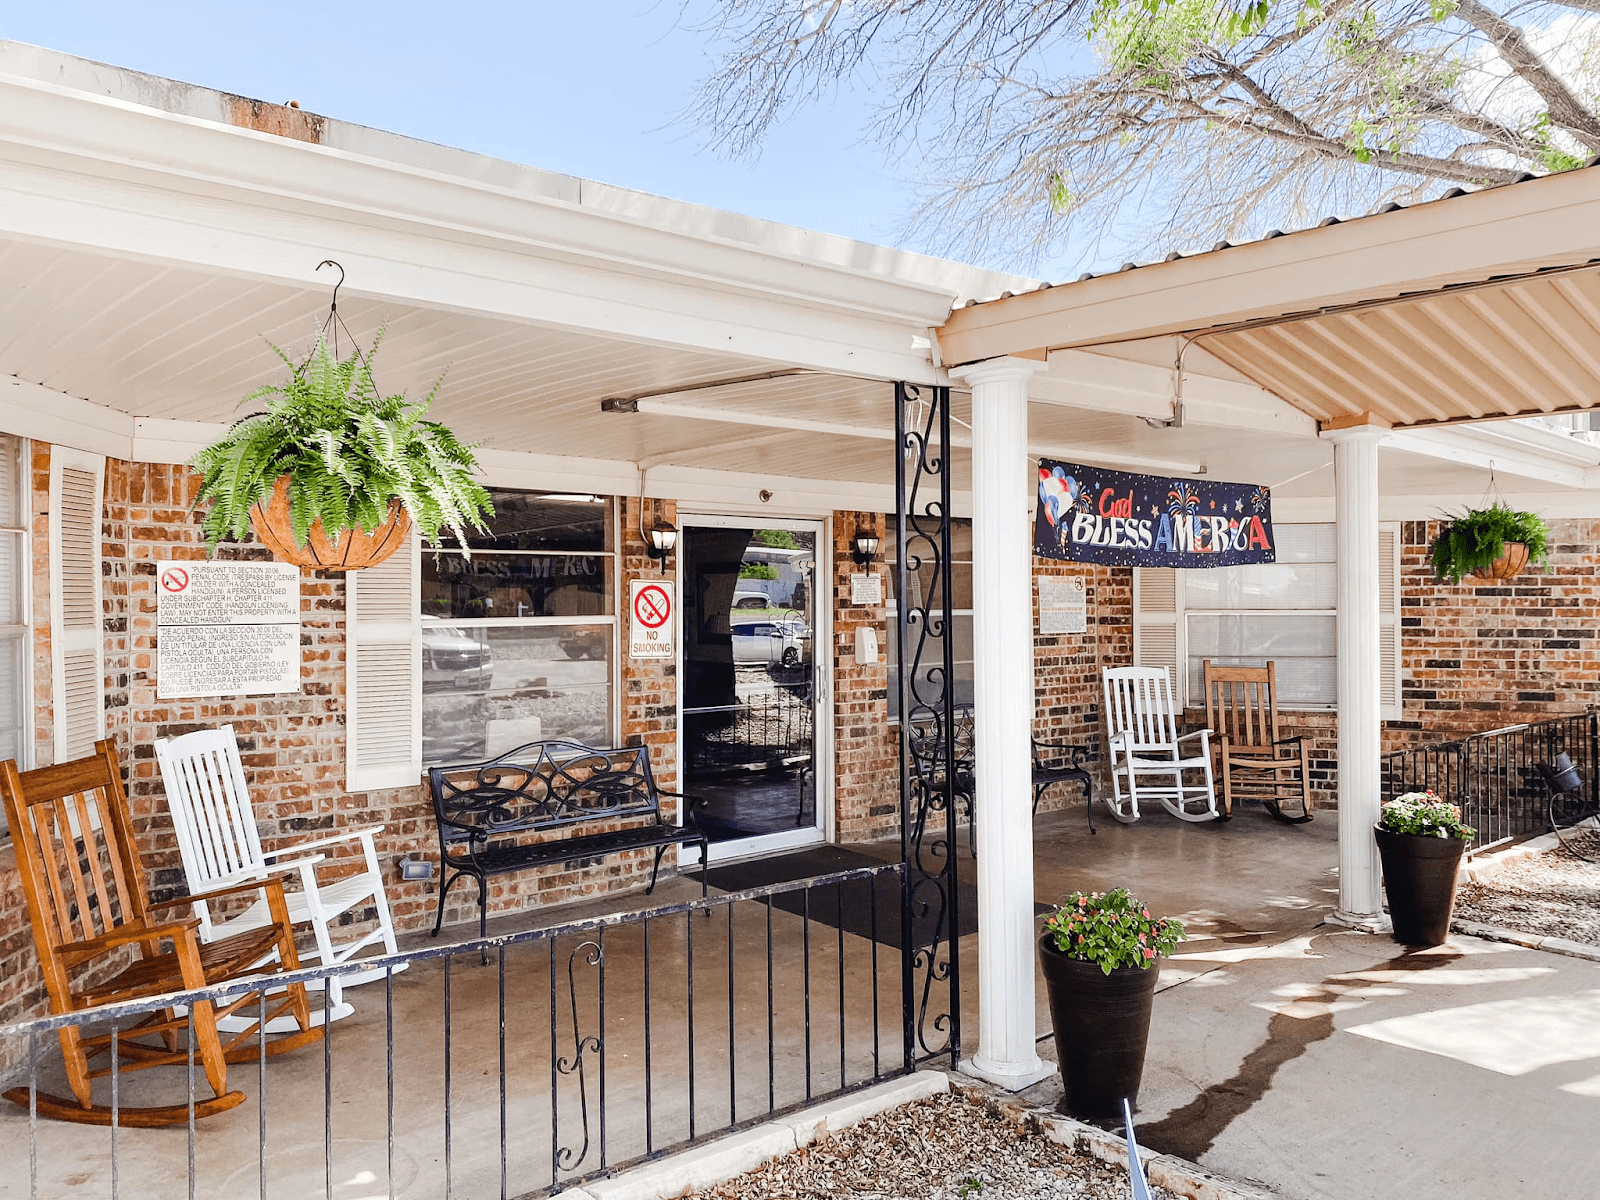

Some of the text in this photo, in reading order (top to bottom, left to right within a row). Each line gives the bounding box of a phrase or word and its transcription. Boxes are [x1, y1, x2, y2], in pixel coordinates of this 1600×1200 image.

[1098, 488, 1134, 518] God
[1072, 513, 1271, 553] BLESS AMERICA
[646, 631, 659, 640] NO
[633, 643, 671, 653] SMOKING
